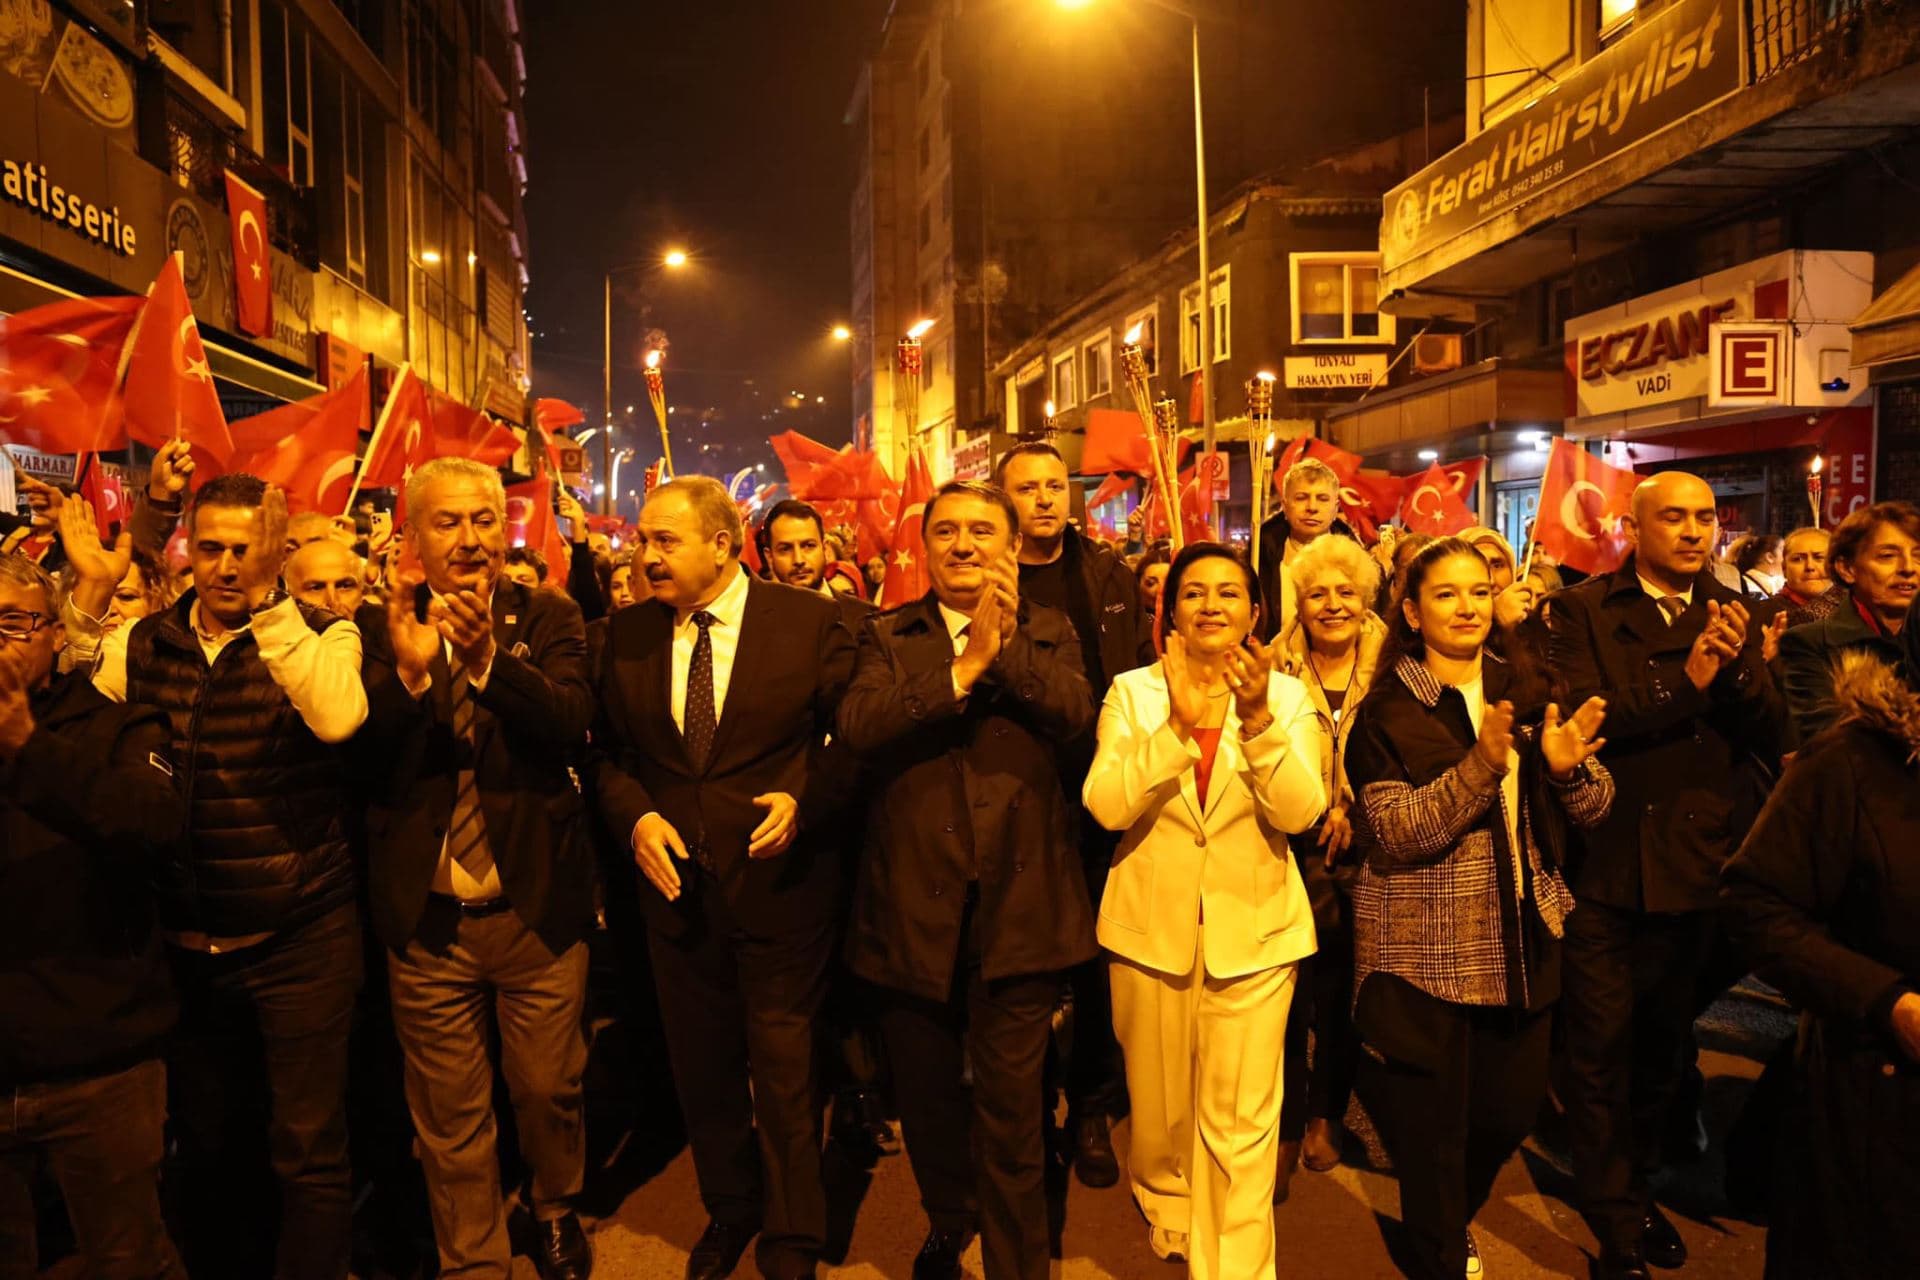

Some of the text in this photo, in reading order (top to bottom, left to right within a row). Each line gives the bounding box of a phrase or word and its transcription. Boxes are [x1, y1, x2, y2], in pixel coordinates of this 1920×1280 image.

[1425, 4, 1722, 224] Ferat Hairstylist
[3, 160, 136, 255] atisserie
[1732, 341, 1767, 388] E
